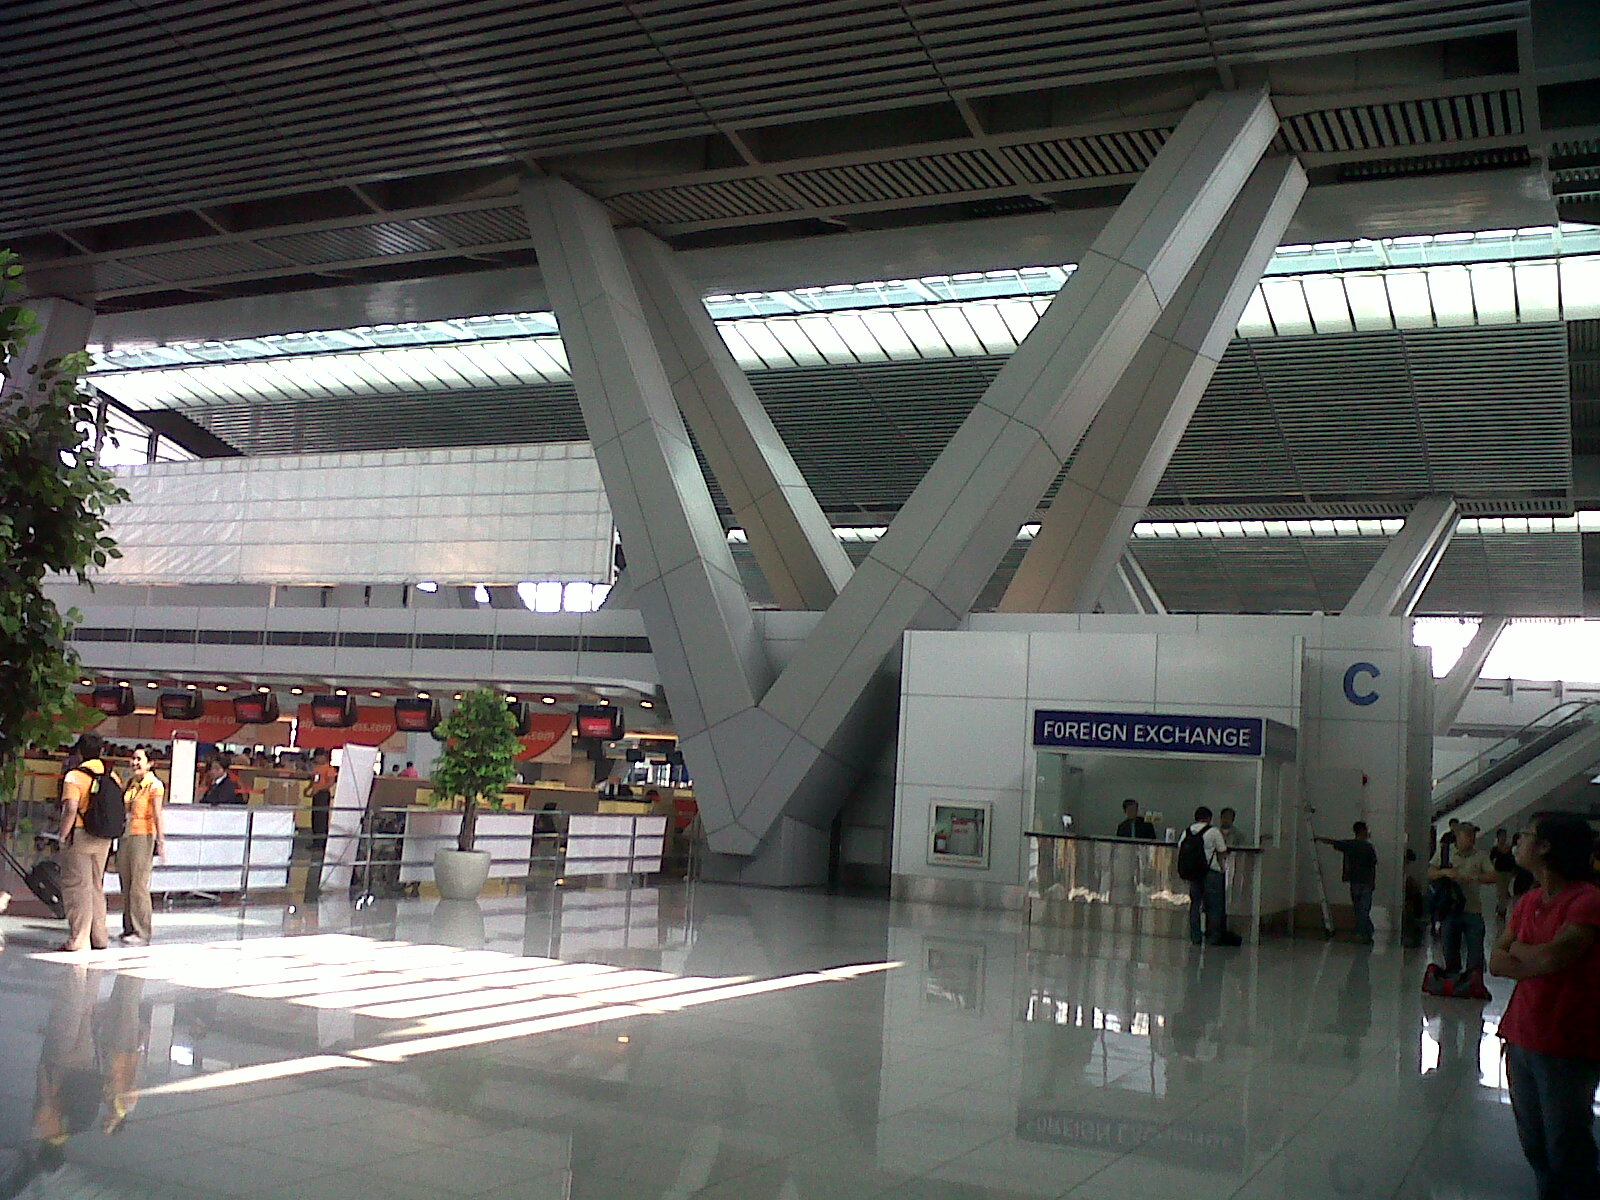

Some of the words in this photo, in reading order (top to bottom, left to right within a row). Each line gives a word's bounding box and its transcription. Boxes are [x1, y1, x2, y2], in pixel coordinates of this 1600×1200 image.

[1343, 662, 1380, 705] C
[1043, 720, 1127, 741] FOREIGN
[1134, 724, 1251, 747] EXCHANGE
